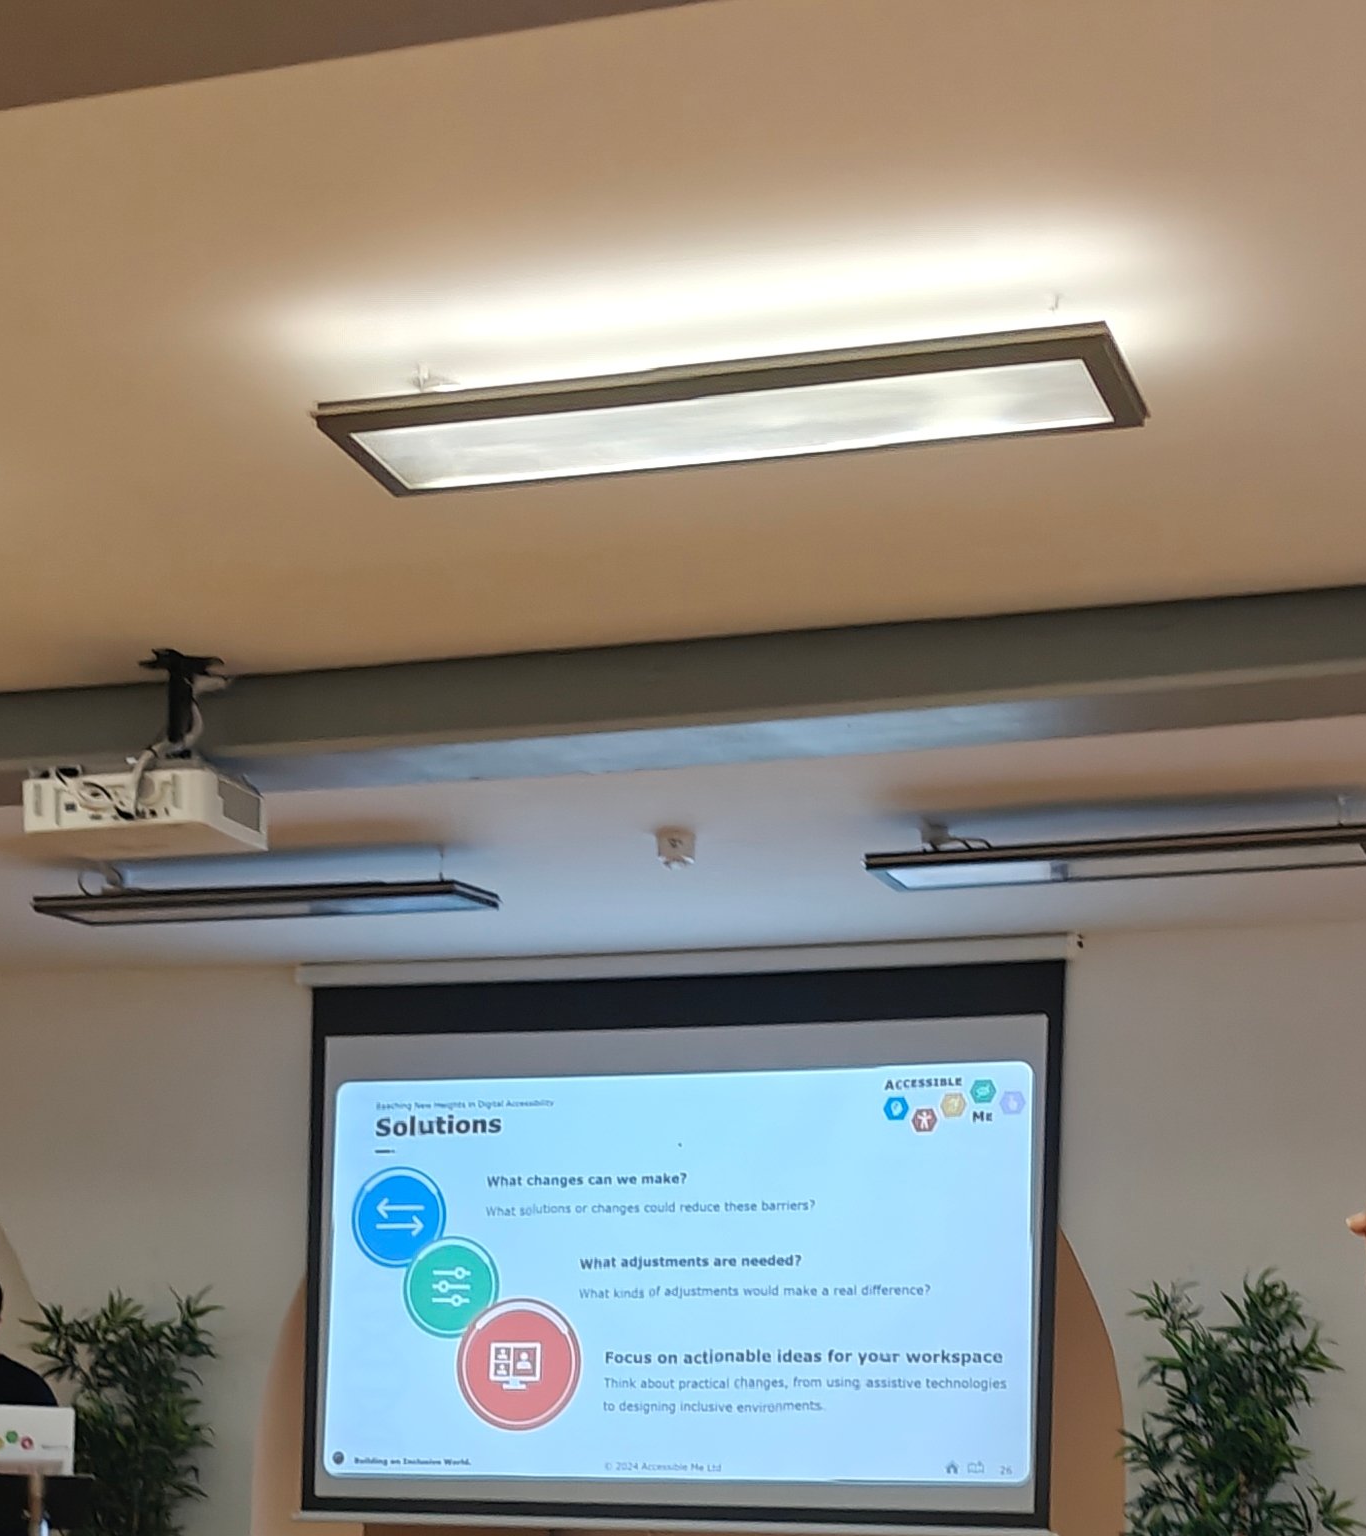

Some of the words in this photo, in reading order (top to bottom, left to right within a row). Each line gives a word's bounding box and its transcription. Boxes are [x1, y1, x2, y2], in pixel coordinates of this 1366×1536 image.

[885, 1077, 963, 1090] ACCESSIBLE
[375, 1114, 502, 1137] Solutions
[487, 1175, 522, 1188] What
[527, 1174, 584, 1189] changes
[588, 1175, 613, 1185] can
[617, 1175, 637, 1185] we
[641, 1173, 687, 1185] make?
[486, 1205, 516, 1217] What
[520, 1203, 572, 1216] solutions
[575, 1204, 587, 1214] or
[591, 1202, 640, 1216] changes
[643, 1201, 676, 1213] could
[680, 1201, 721, 1212] reduce
[724, 1200, 757, 1212] these
[761, 1199, 816, 1212] barriers?
[579, 1256, 617, 1271] What
[620, 1255, 710, 1271] adjustments
[713, 1257, 737, 1267] are
[740, 1254, 802, 1268] needed?
[579, 1287, 610, 1300] What
[613, 1287, 645, 1299] kinds
[648, 1285, 661, 1298] of
[664, 1284, 739, 1300] adjustments
[743, 1284, 779, 1296] would
[783, 1284, 818, 1296] make
[821, 1286, 830, 1296] a
[833, 1284, 857, 1296] real
[861, 1283, 931, 1296] difference?
[605, 1351, 652, 1365] Focus
[657, 1352, 678, 1364] on
[683, 1349, 772, 1365] actionable
[777, 1348, 822, 1363] ideas
[828, 1349, 853, 1363] for
[858, 1352, 900, 1366] your
[906, 1349, 1003, 1366] workspace
[604, 1377, 637, 1389] Think
[640, 1377, 675, 1389] about
[678, 1377, 730, 1391] practical
[734, 1375, 789, 1391] changes,
[793, 1376, 822, 1388] from
[826, 1377, 861, 1391] using
[865, 1377, 922, 1389] assistive
[925, 1376, 1007, 1392] technologies
[603, 1401, 615, 1412] to
[619, 1400, 676, 1415] designing
[680, 1400, 733, 1413] inclusive
[736, 1400, 825, 1414] environments.
[615, 1461, 639, 1471] 2024
